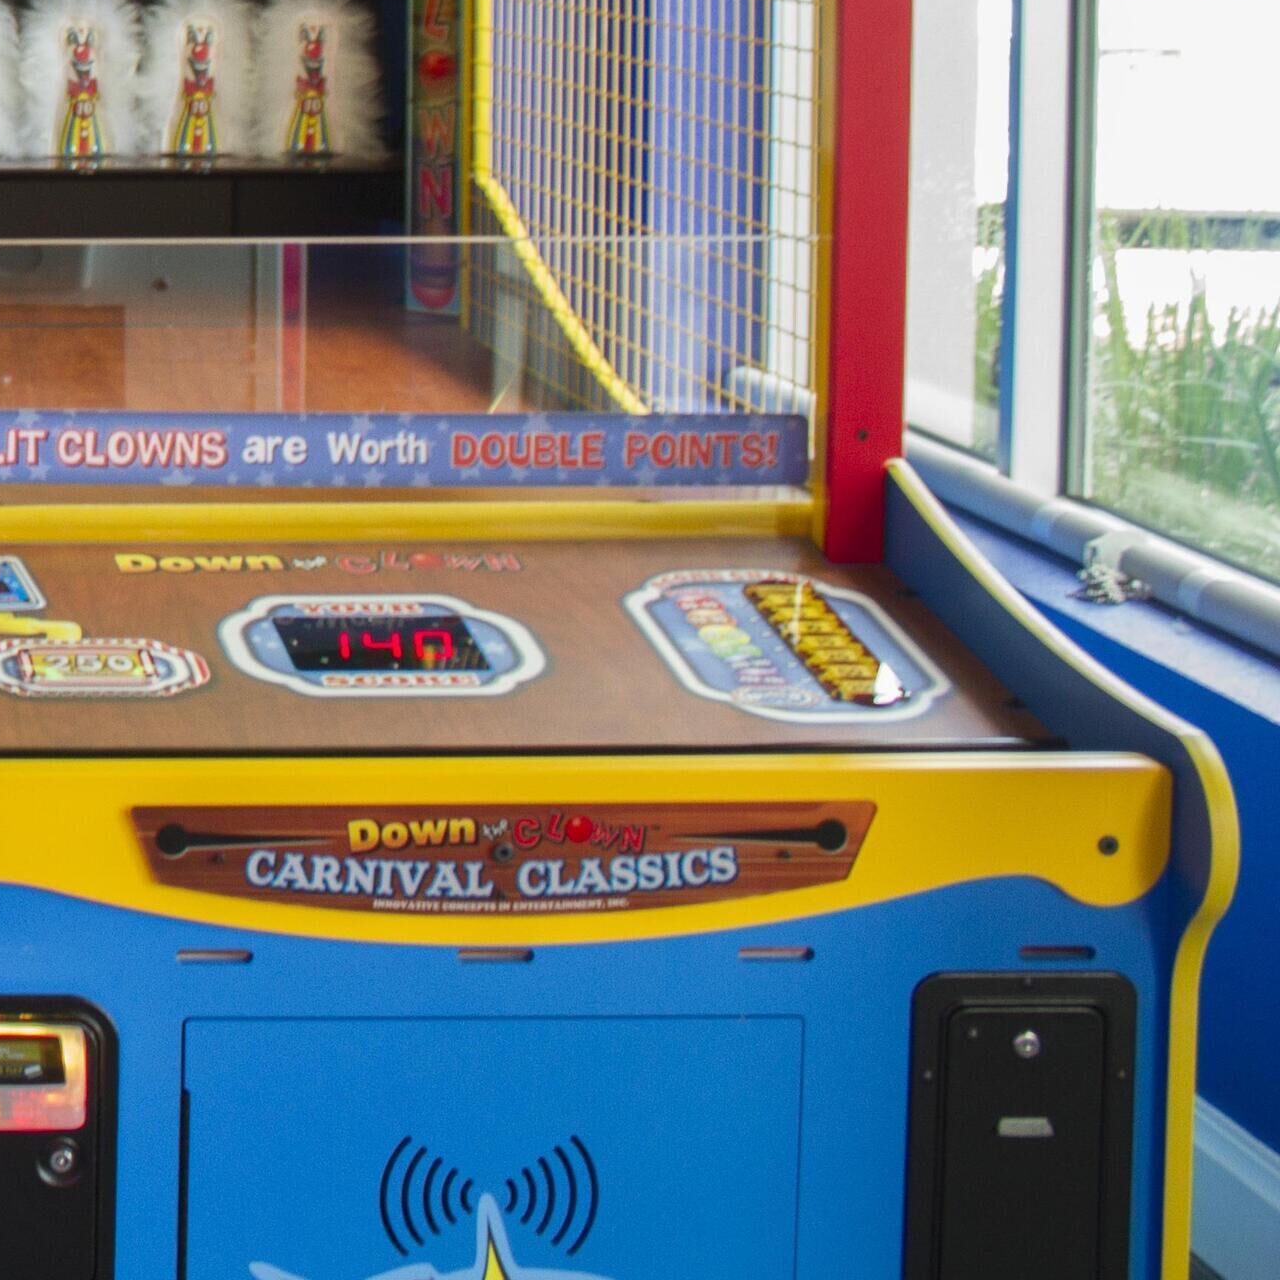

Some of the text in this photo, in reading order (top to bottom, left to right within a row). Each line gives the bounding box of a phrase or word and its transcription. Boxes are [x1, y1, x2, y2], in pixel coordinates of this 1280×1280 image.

[56, 428, 229, 468] CLOWNS
[242, 433, 308, 465] are
[327, 430, 428, 465] Worth
[451, 430, 606, 470] DOUBLE
[623, 430, 781, 470] POINTS!
[45, 652, 134, 676] 250
[338, 630, 454, 663] 140
[481, 818, 511, 842] the
[514, 811, 646, 851] CLOWN
[244, 846, 739, 900] CARNIVAL CLASSICS
[372, 898, 440, 912] INNOVATIVE
[442, 900, 497, 913] CONCEPTS
[498, 900, 510, 912] IN
